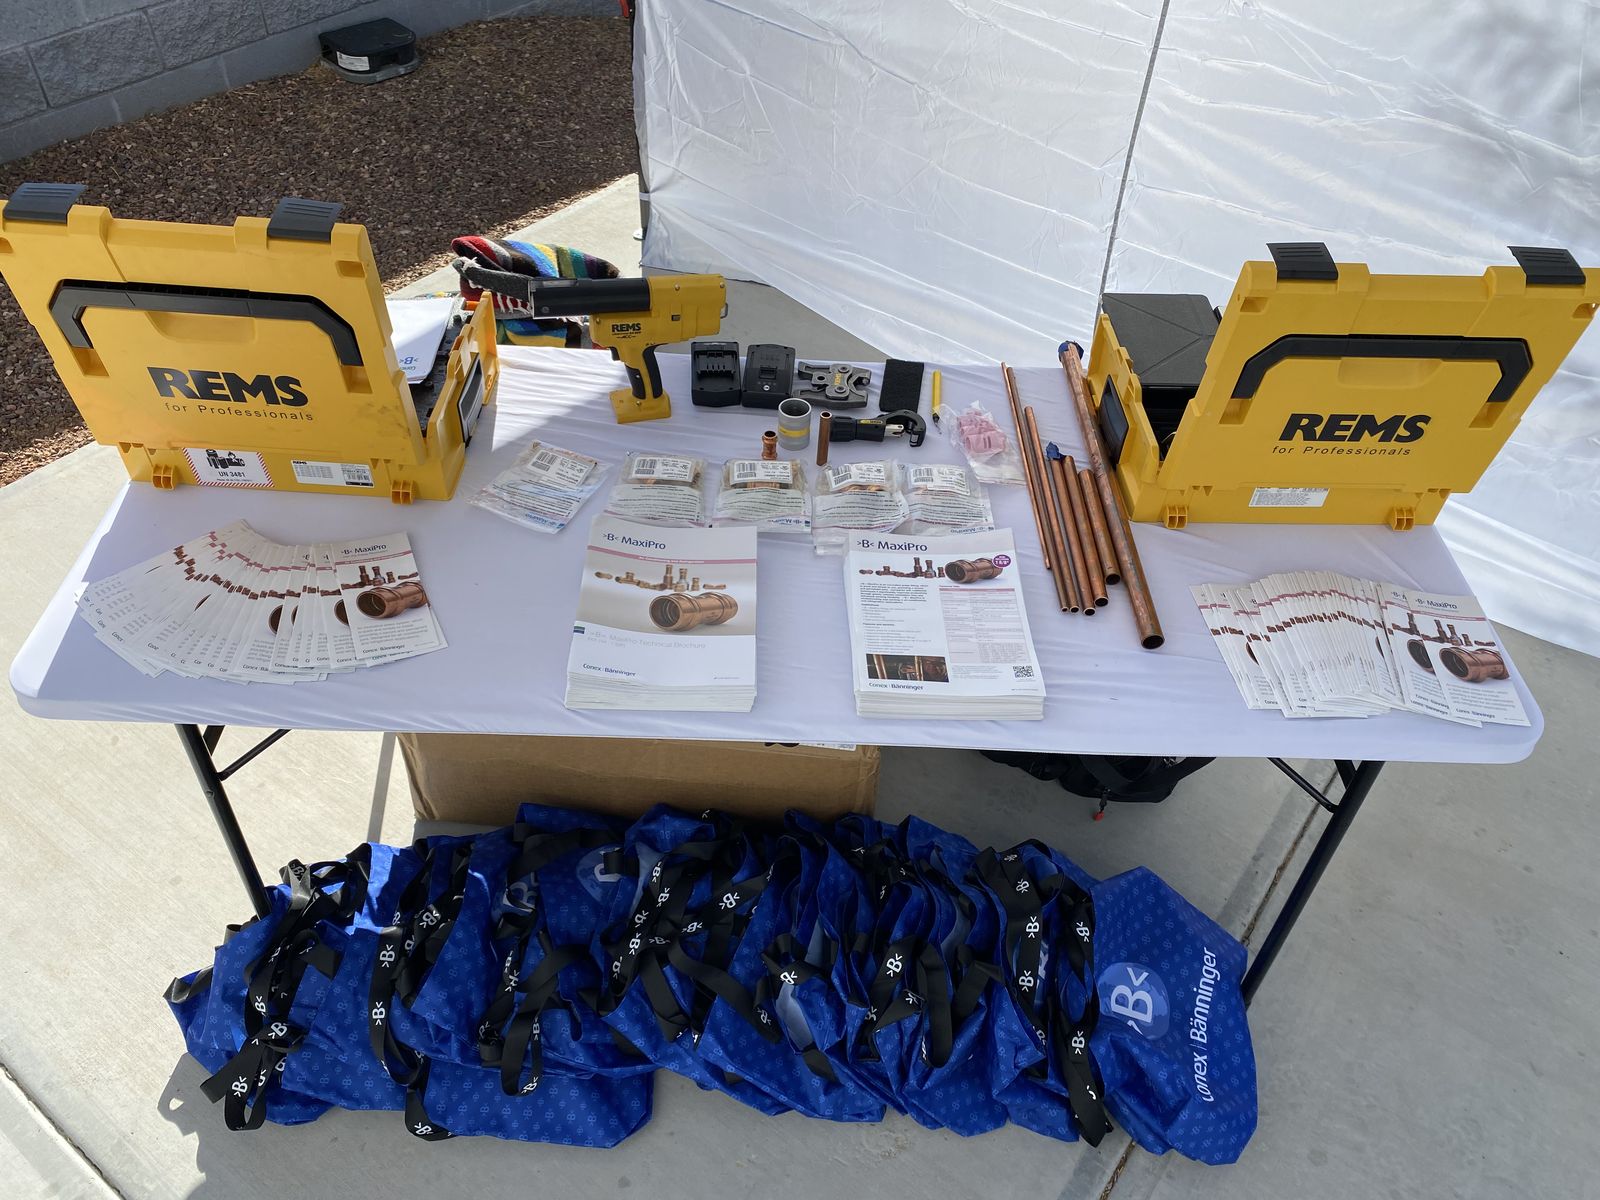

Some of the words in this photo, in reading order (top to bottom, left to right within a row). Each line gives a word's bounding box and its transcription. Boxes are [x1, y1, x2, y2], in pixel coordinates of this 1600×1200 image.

[612, 322, 642, 332] REMS
[147, 366, 309, 407] REMS
[165, 402, 188, 412] for
[199, 405, 314, 421] Professionals
[1279, 413, 1432, 443] REMS
[1272, 446, 1295, 454] for
[1303, 446, 1411, 456] Professionals
[354, 544, 387, 554] MaxiPro
[620, 536, 666, 550] MaxiPro
[877, 540, 928, 552] MaxiPro
[1427, 600, 1458, 609] MaxiPro
[582, 663, 601, 671] Conex
[1190, 946, 1221, 1044] Bänninger
